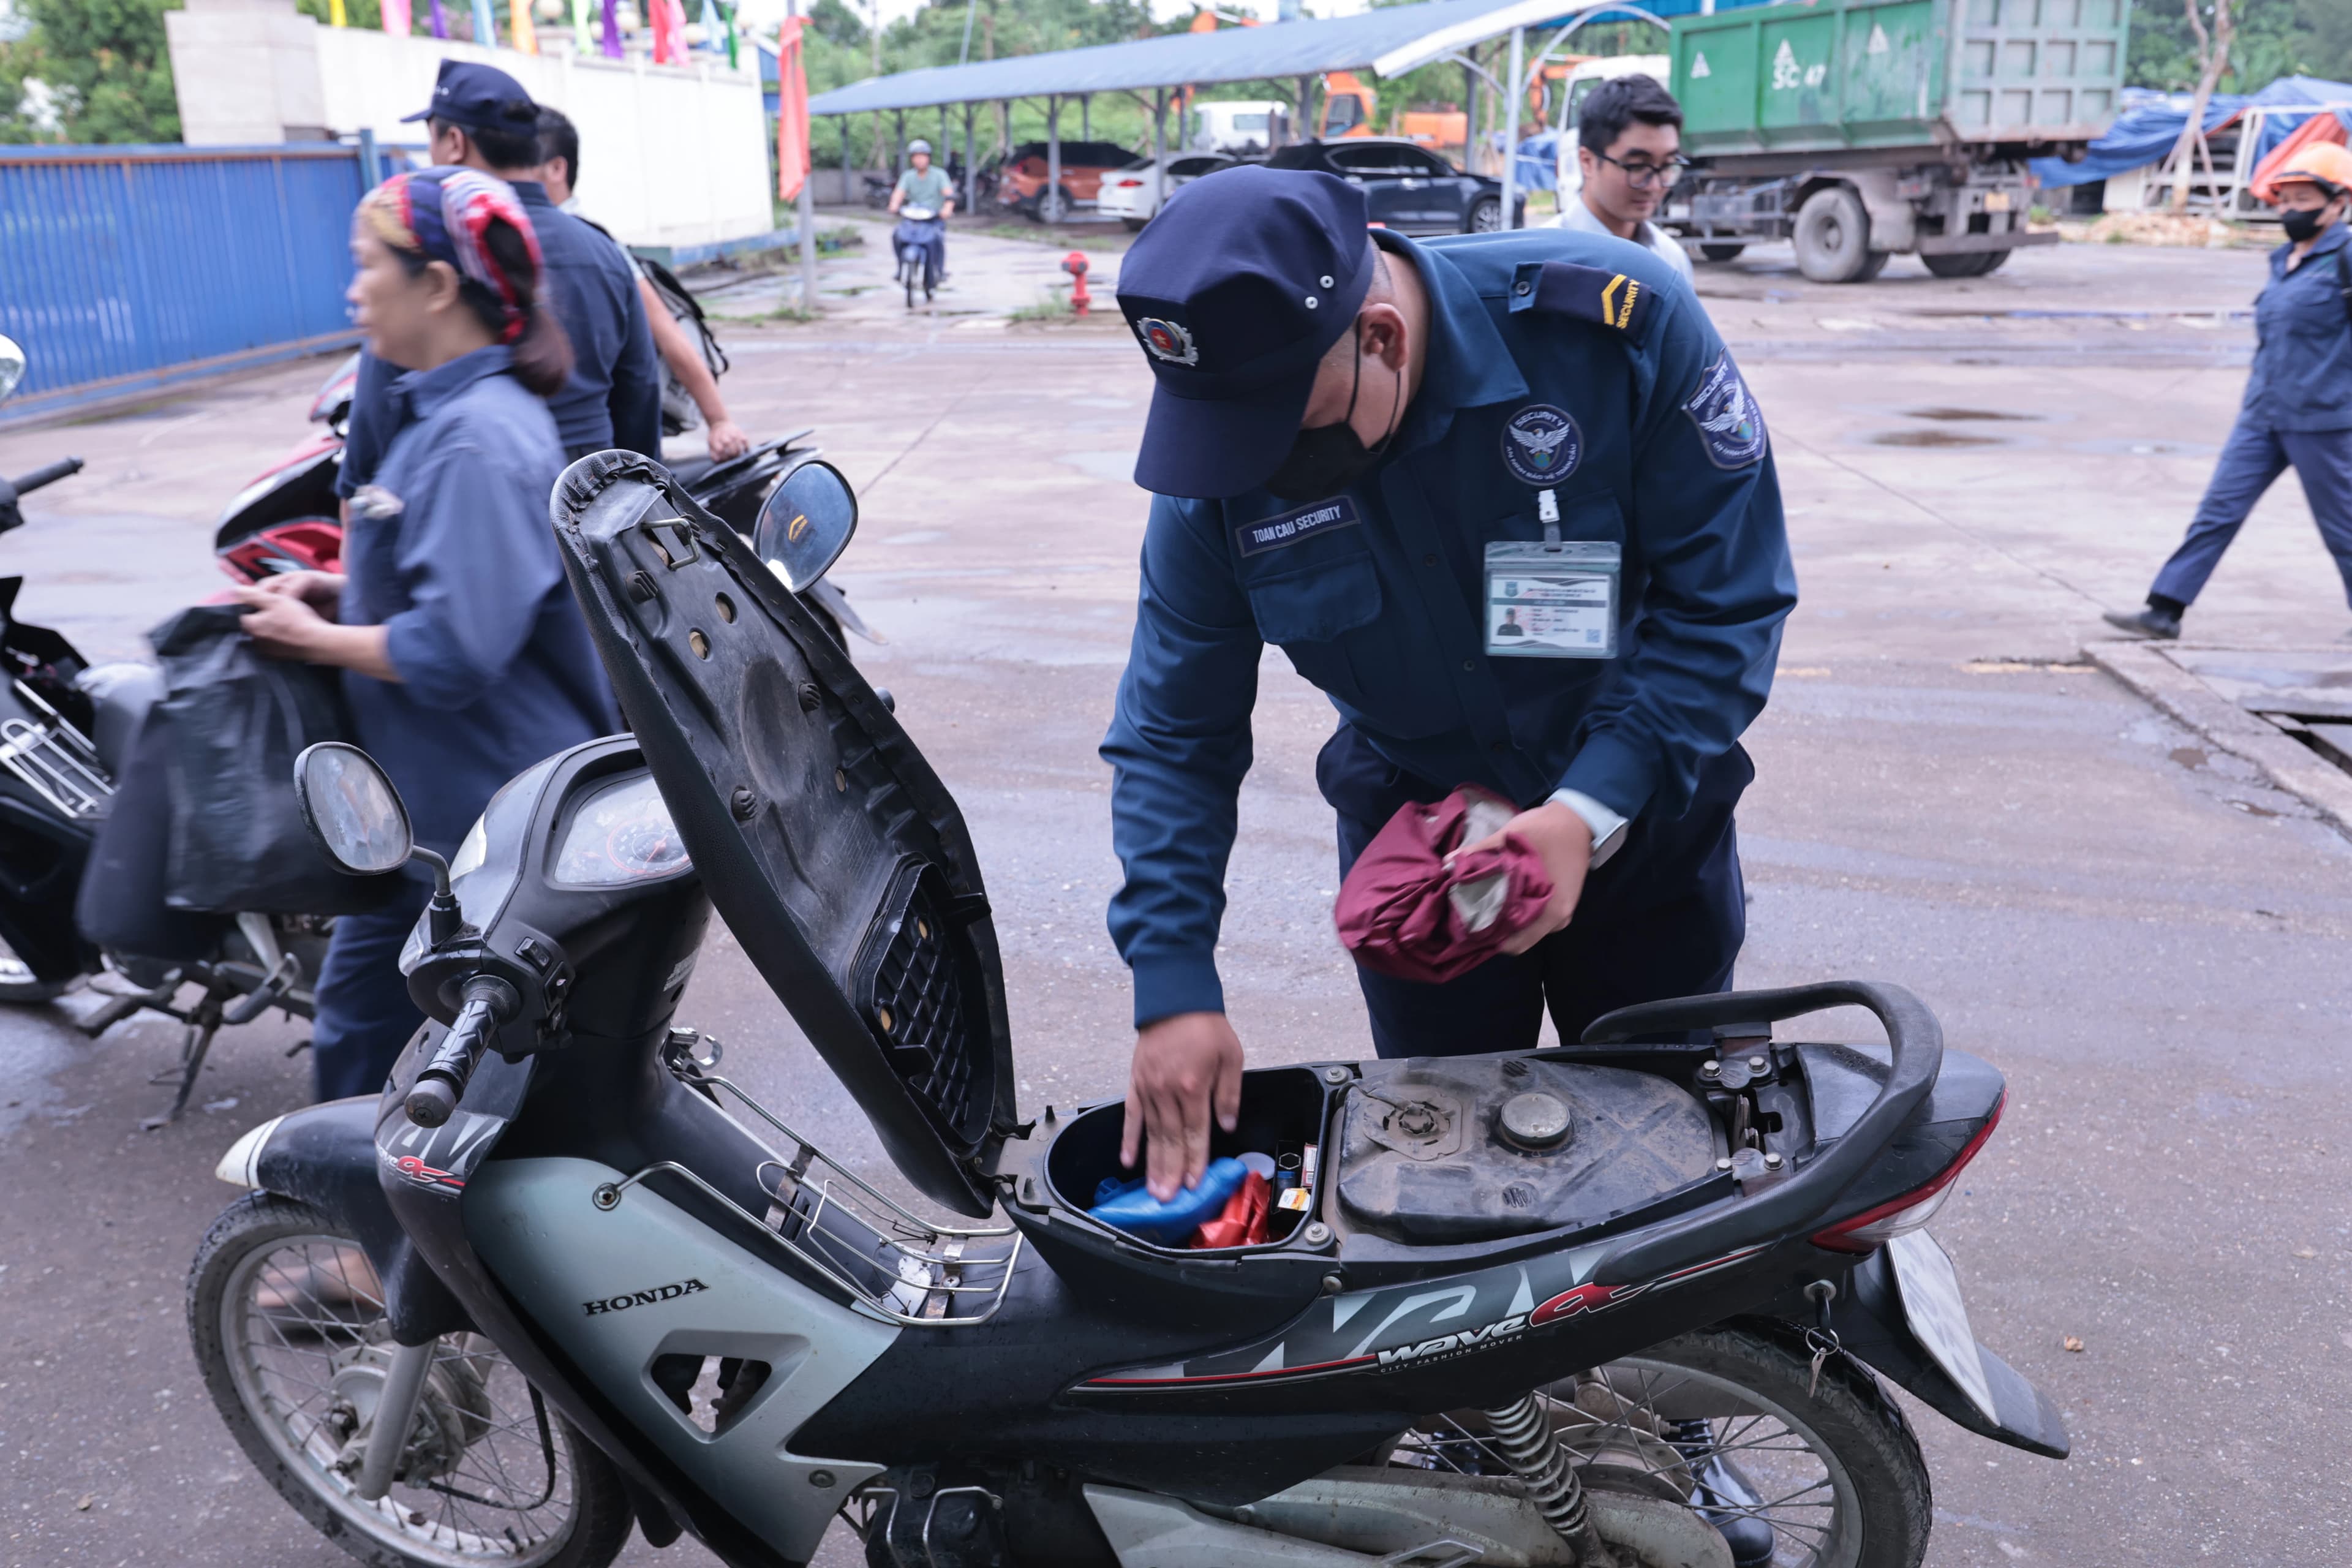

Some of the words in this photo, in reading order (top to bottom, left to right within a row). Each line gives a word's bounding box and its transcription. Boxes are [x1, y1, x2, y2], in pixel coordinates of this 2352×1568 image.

[1616, 279, 1641, 330] SECURITY
[1690, 361, 1728, 411] SECURITY
[1514, 411, 1566, 428] SECURITY
[1253, 526, 1276, 543] TOAN
[1276, 521, 1296, 538] CAU
[1295, 505, 1341, 530] SECURITY
[582, 1278, 709, 1316] HONDA
[1380, 1363, 1409, 1373] CITY
[1417, 1348, 1471, 1365] FASHION
[1480, 1334, 1523, 1350] MOVER
